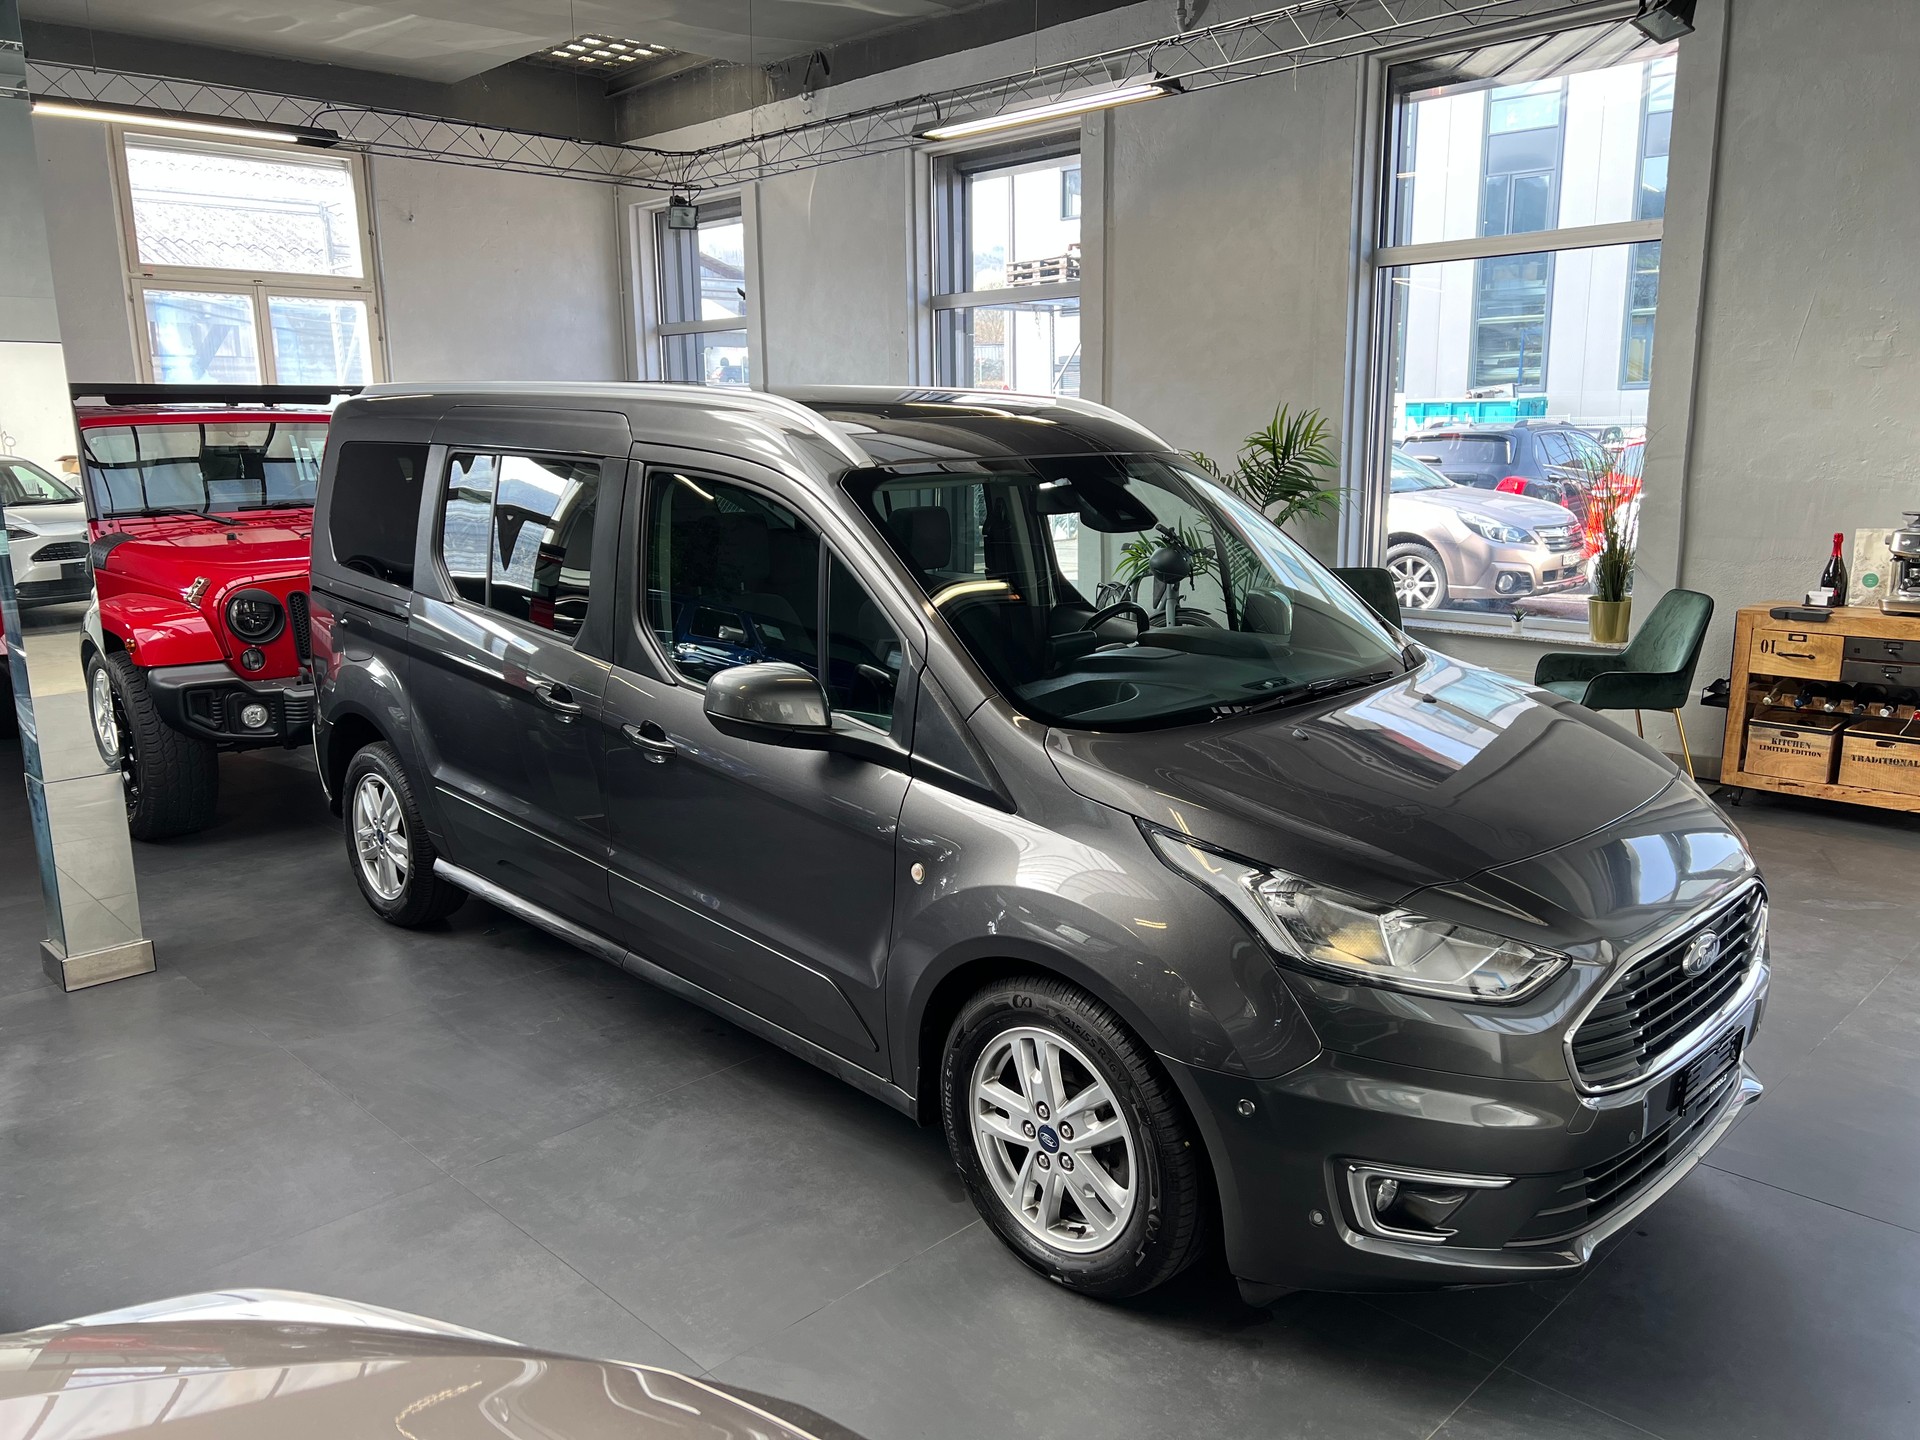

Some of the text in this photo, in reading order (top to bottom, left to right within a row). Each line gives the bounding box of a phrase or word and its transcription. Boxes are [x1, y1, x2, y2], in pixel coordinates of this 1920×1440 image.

[1771, 737, 1812, 750] KITCHEN
[1759, 744, 1822, 758] LIMITED EDITION
[1851, 754, 1920, 768] TRADITIONAL
[1063, 1016, 1097, 1048] 215/55
[1097, 1047, 1107, 1059] R
